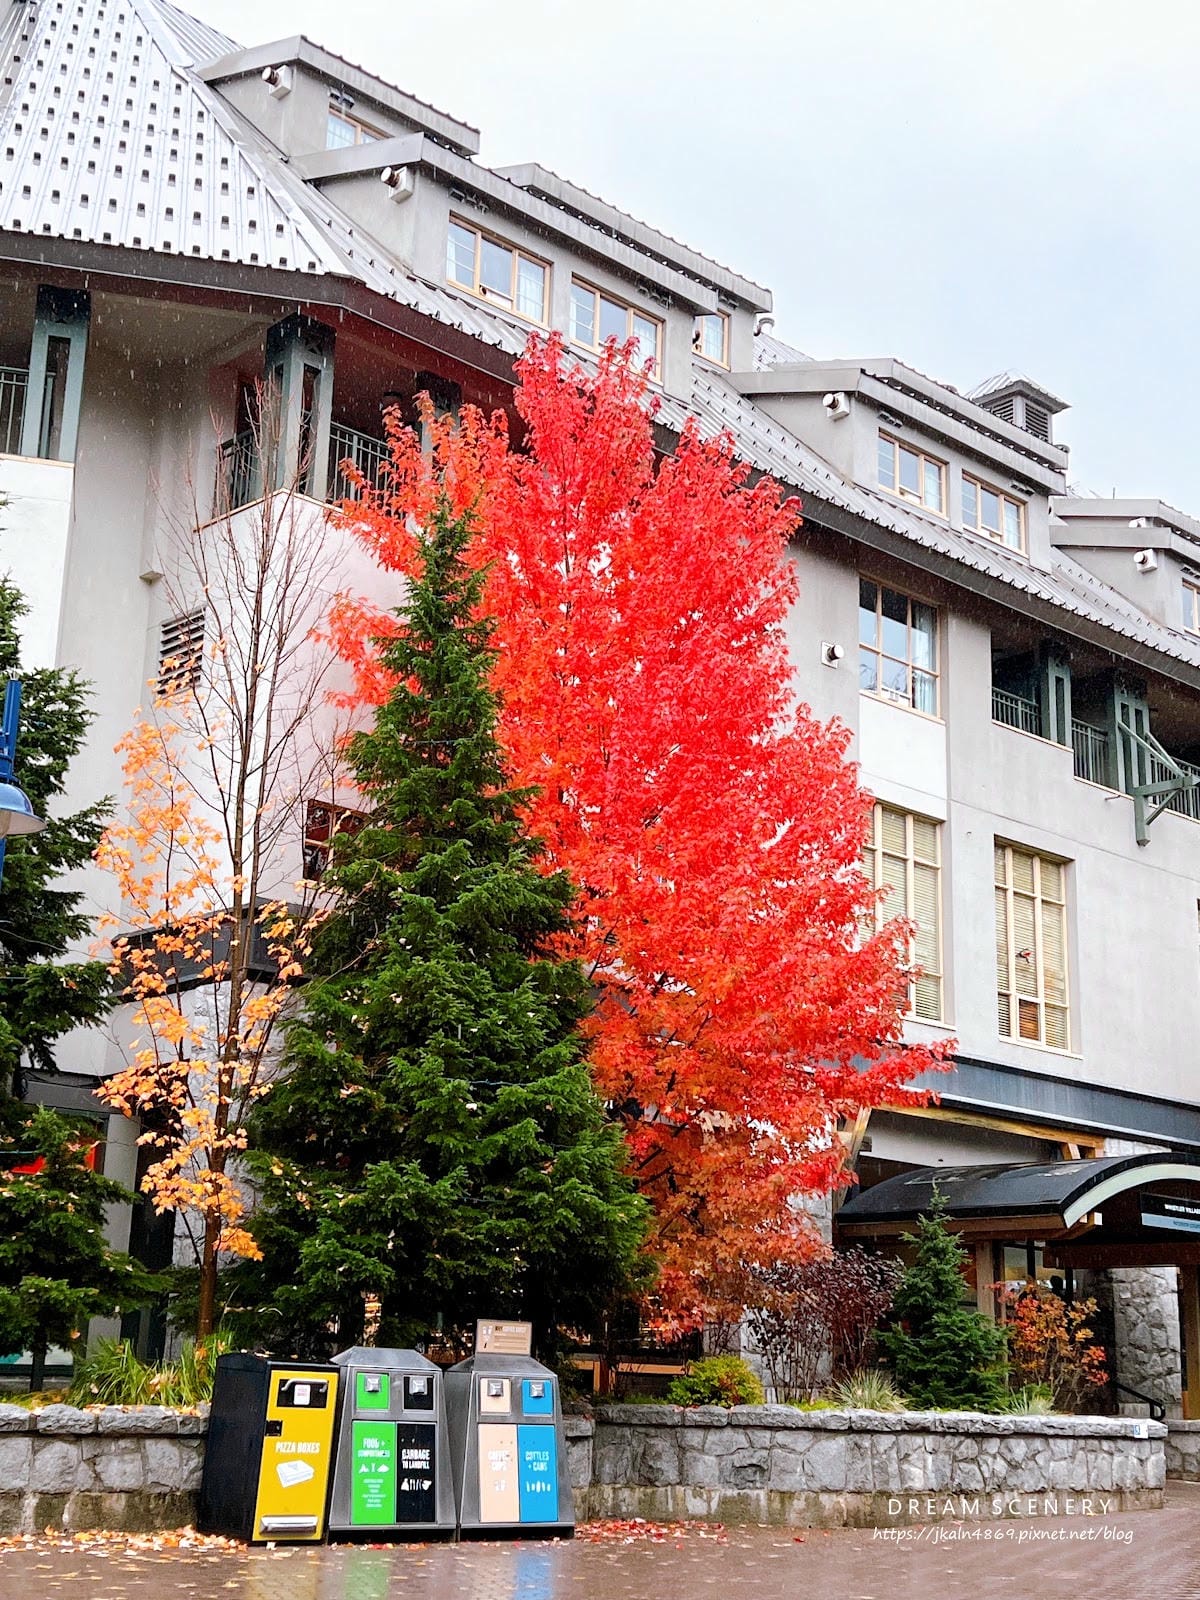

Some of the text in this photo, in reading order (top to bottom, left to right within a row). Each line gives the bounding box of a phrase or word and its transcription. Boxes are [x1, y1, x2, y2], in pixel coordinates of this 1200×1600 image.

[276, 1442, 320, 1454] PIZZA BOXES
[363, 1438, 379, 1448] FOOD
[402, 1449, 430, 1460] GARBAGE
[525, 1451, 549, 1461] BOTTLES
[402, 1460, 430, 1469] TO LANDFILL
[533, 1462, 547, 1471] CANS
